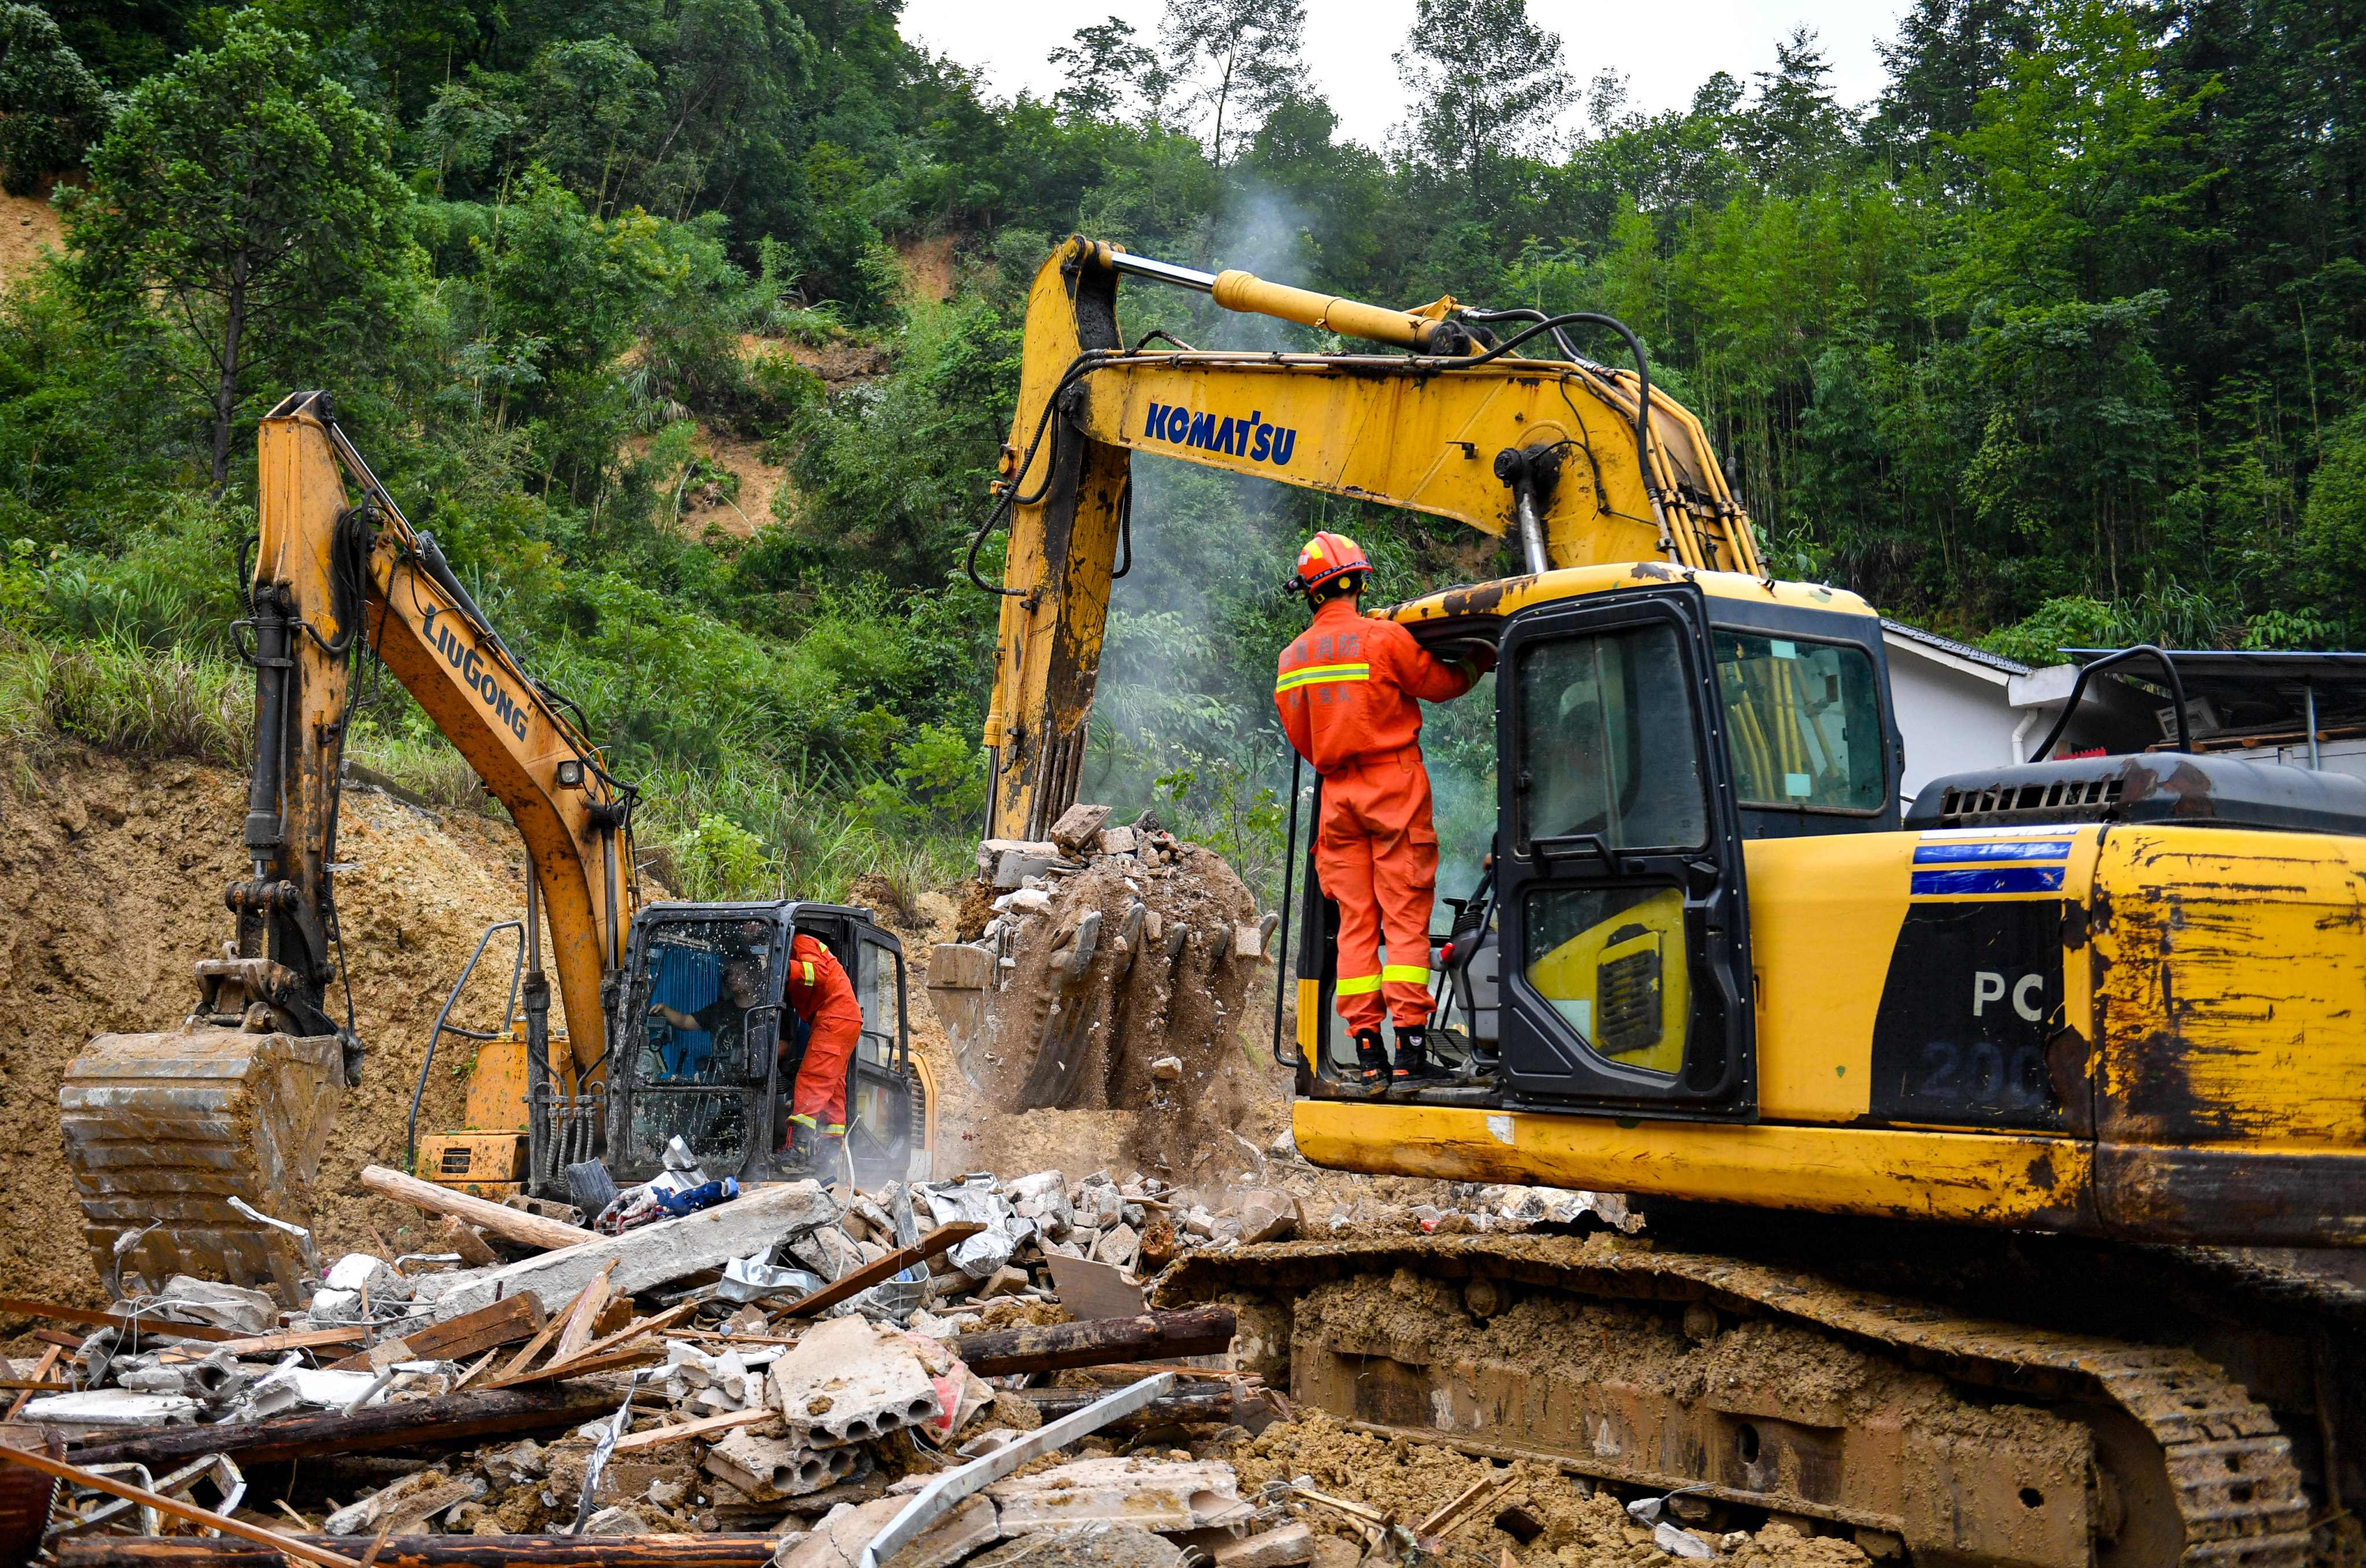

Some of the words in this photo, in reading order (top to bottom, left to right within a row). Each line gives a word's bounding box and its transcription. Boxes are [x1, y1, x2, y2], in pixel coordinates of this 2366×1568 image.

[1144, 403, 1297, 466] KOMATSU
[422, 602, 529, 742] LIUGONG
[1973, 972, 2044, 1021] PC
